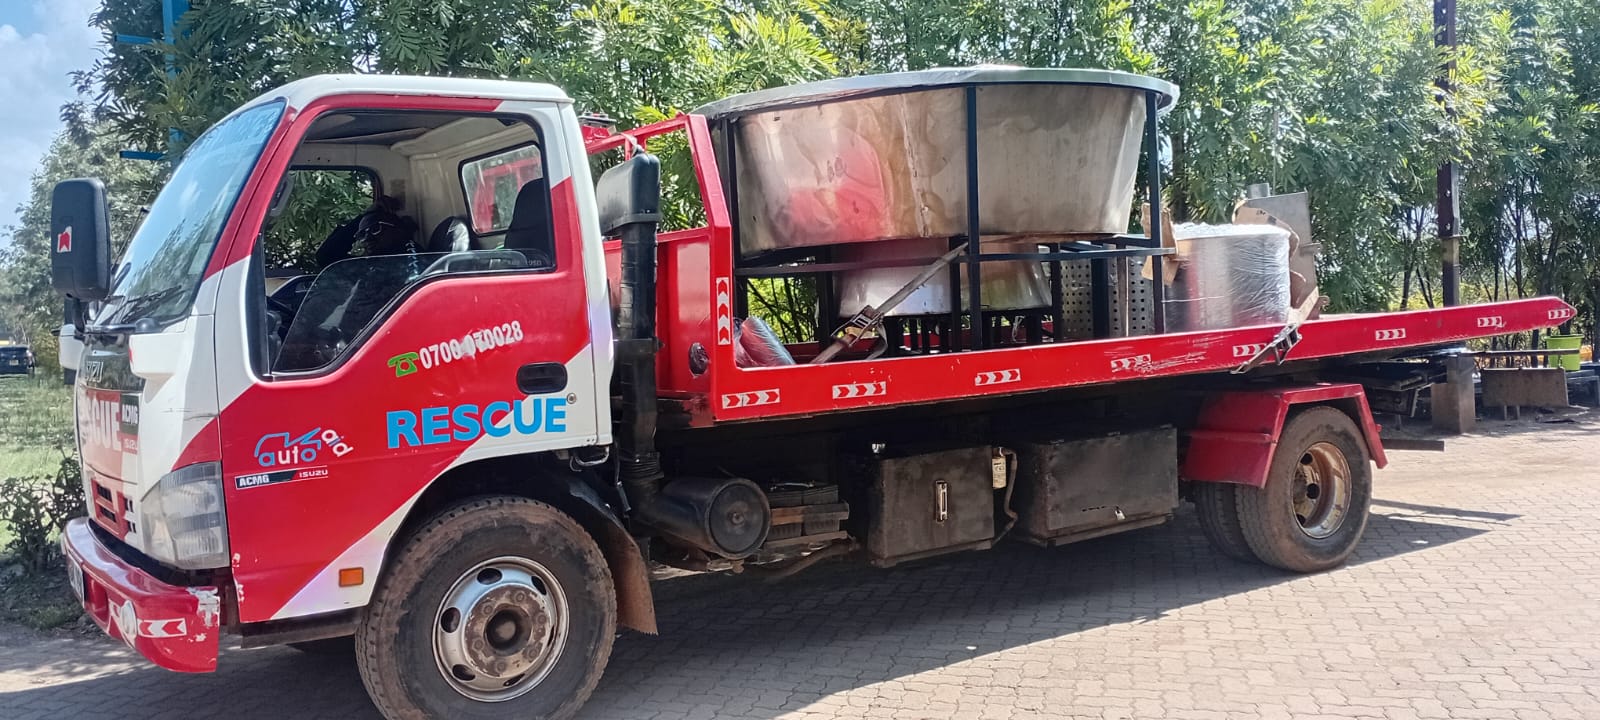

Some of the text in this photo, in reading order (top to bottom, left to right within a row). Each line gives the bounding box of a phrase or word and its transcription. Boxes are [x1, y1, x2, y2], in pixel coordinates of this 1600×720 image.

[386, 397, 568, 449] RESCUE
[258, 429, 354, 467] auto aid
[239, 474, 270, 487] ACMG
[299, 469, 329, 478] ISUZU
